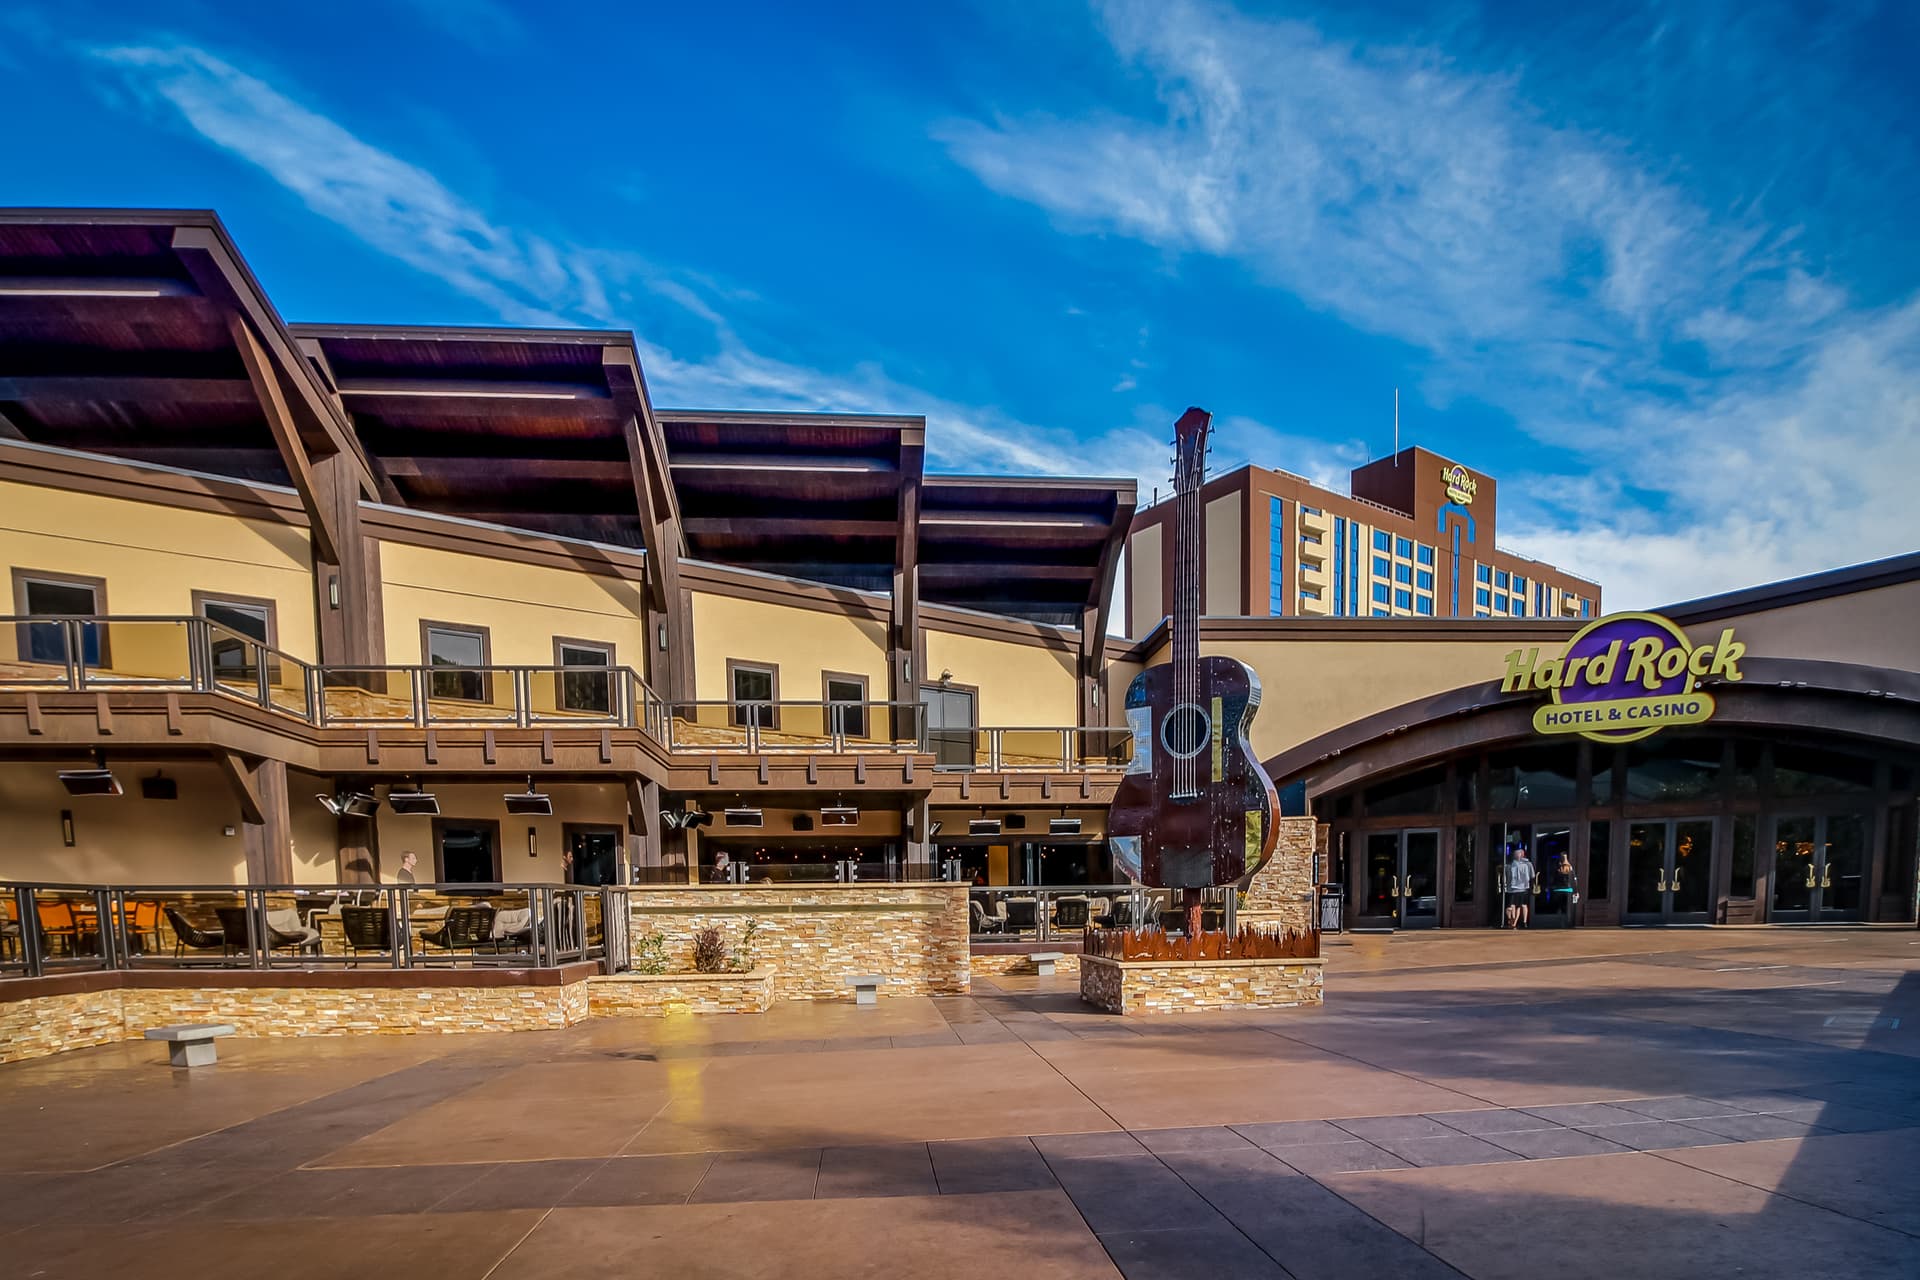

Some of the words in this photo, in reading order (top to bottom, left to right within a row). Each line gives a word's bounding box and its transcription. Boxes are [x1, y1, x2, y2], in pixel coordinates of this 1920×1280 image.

[1442, 467, 1461, 485] Hard
[1461, 474, 1477, 495] Rock
[1501, 640, 1623, 693] Hard
[1625, 628, 1746, 689] Rock
[1546, 711, 1603, 725] HOTEL
[1607, 707, 1622, 721] &
[1626, 701, 1700, 719] CASINO
